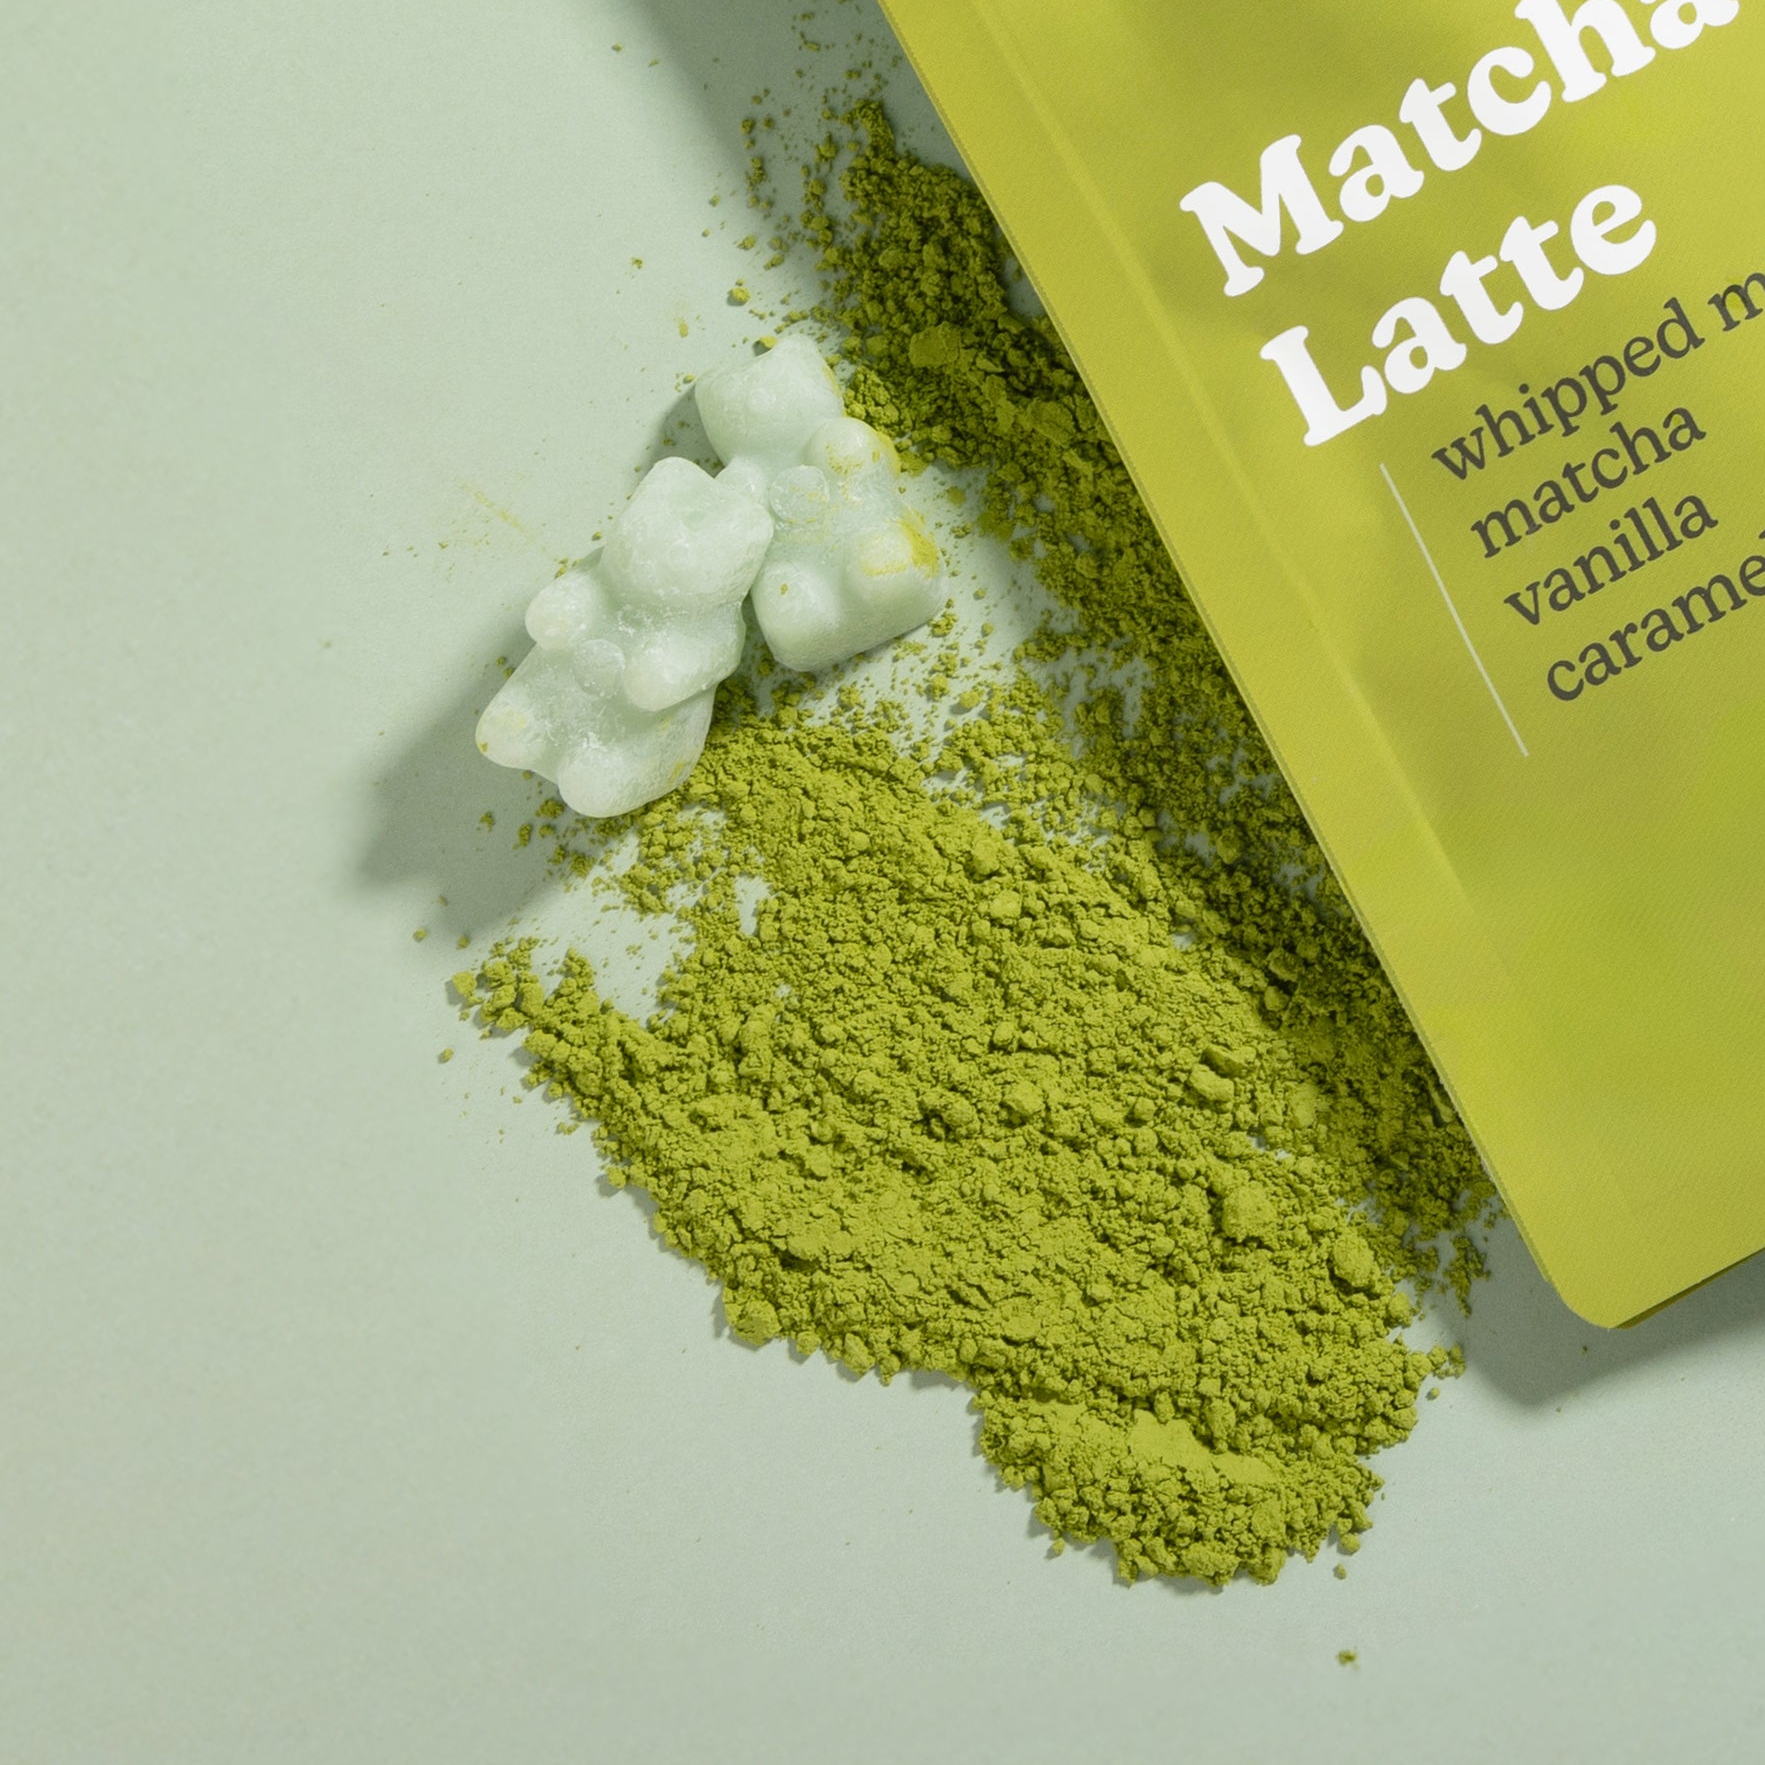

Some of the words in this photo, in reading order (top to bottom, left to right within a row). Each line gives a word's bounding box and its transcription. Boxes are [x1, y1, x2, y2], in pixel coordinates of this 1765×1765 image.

[1259, 184, 1657, 447] Latte
[1431, 297, 1706, 481] whipped
[1470, 407, 1707, 559] matcha
[1503, 495, 1719, 626] vanilla
